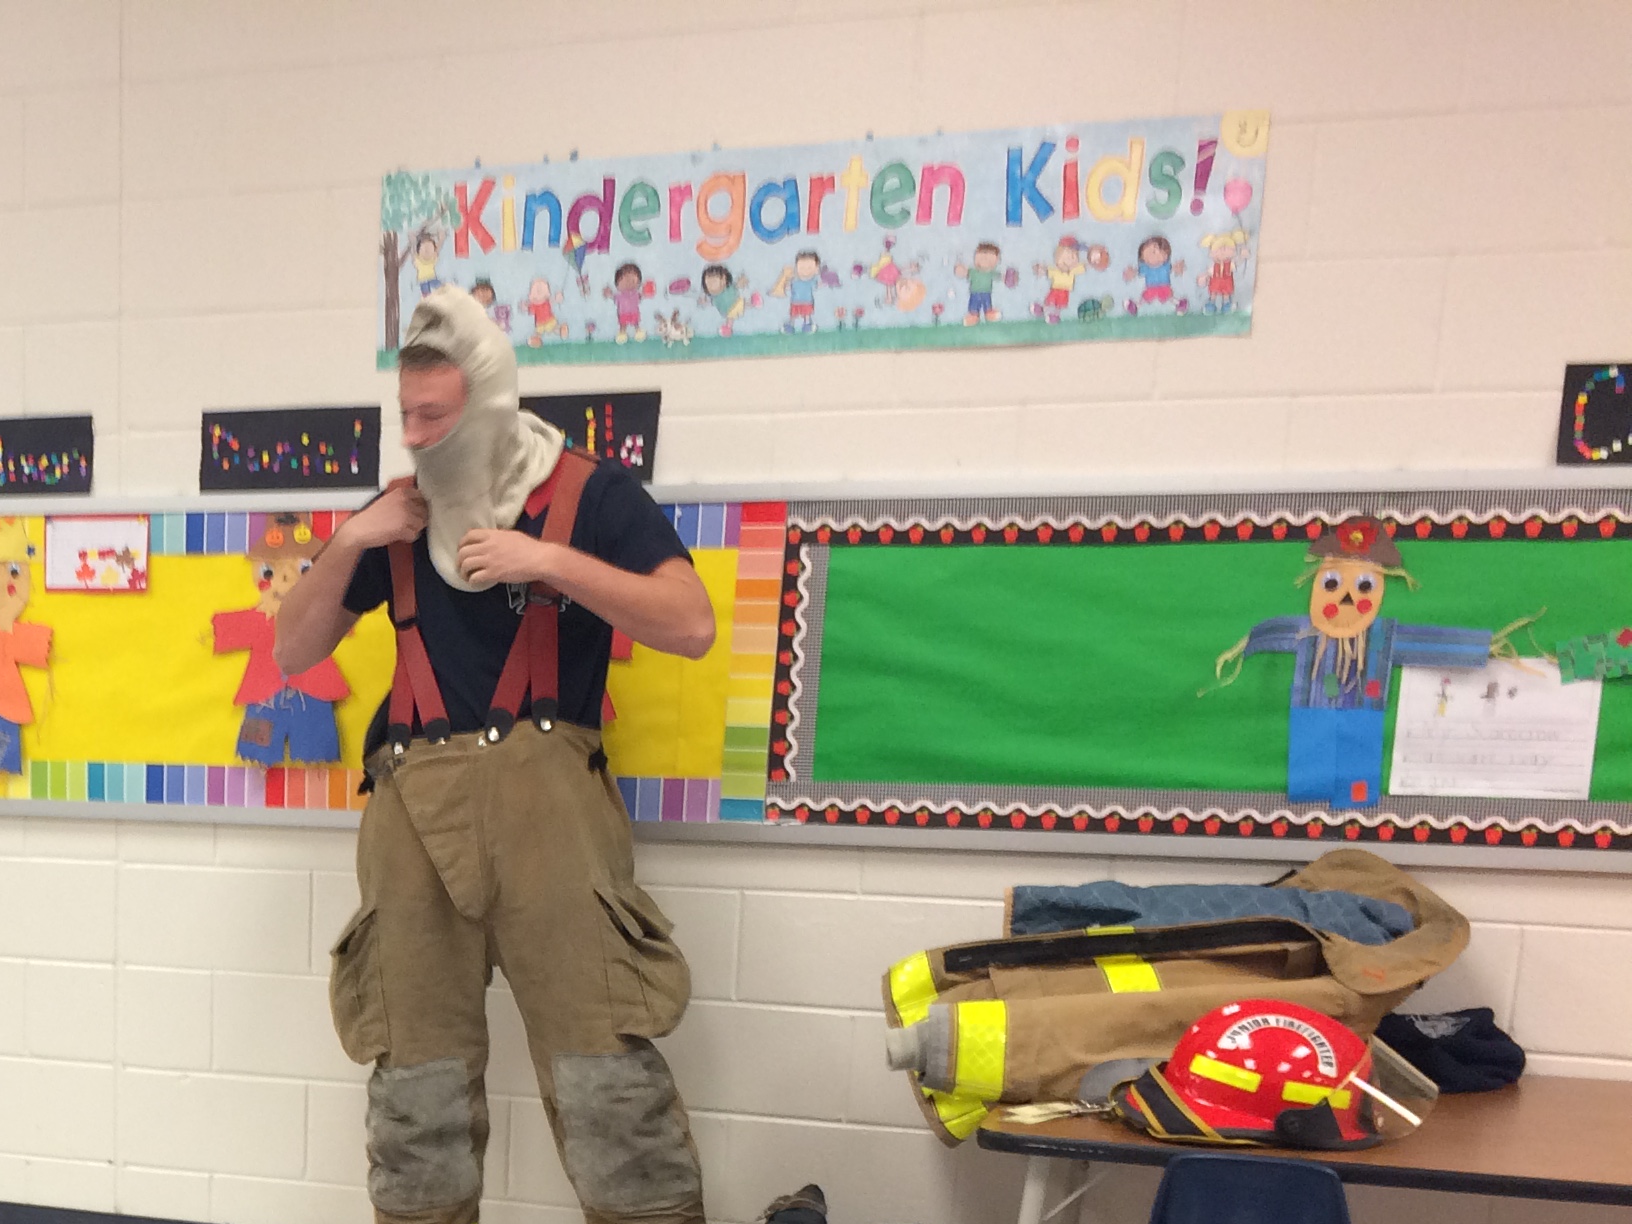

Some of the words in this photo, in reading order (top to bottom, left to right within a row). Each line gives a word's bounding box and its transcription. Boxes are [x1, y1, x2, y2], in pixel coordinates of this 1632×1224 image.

[452, 154, 967, 261] Kindergarten
[1005, 135, 1218, 228] Kids!
[1226, 1017, 1271, 1044] JUNIOR
[1274, 1017, 1334, 1068] FIREFIGHTER
